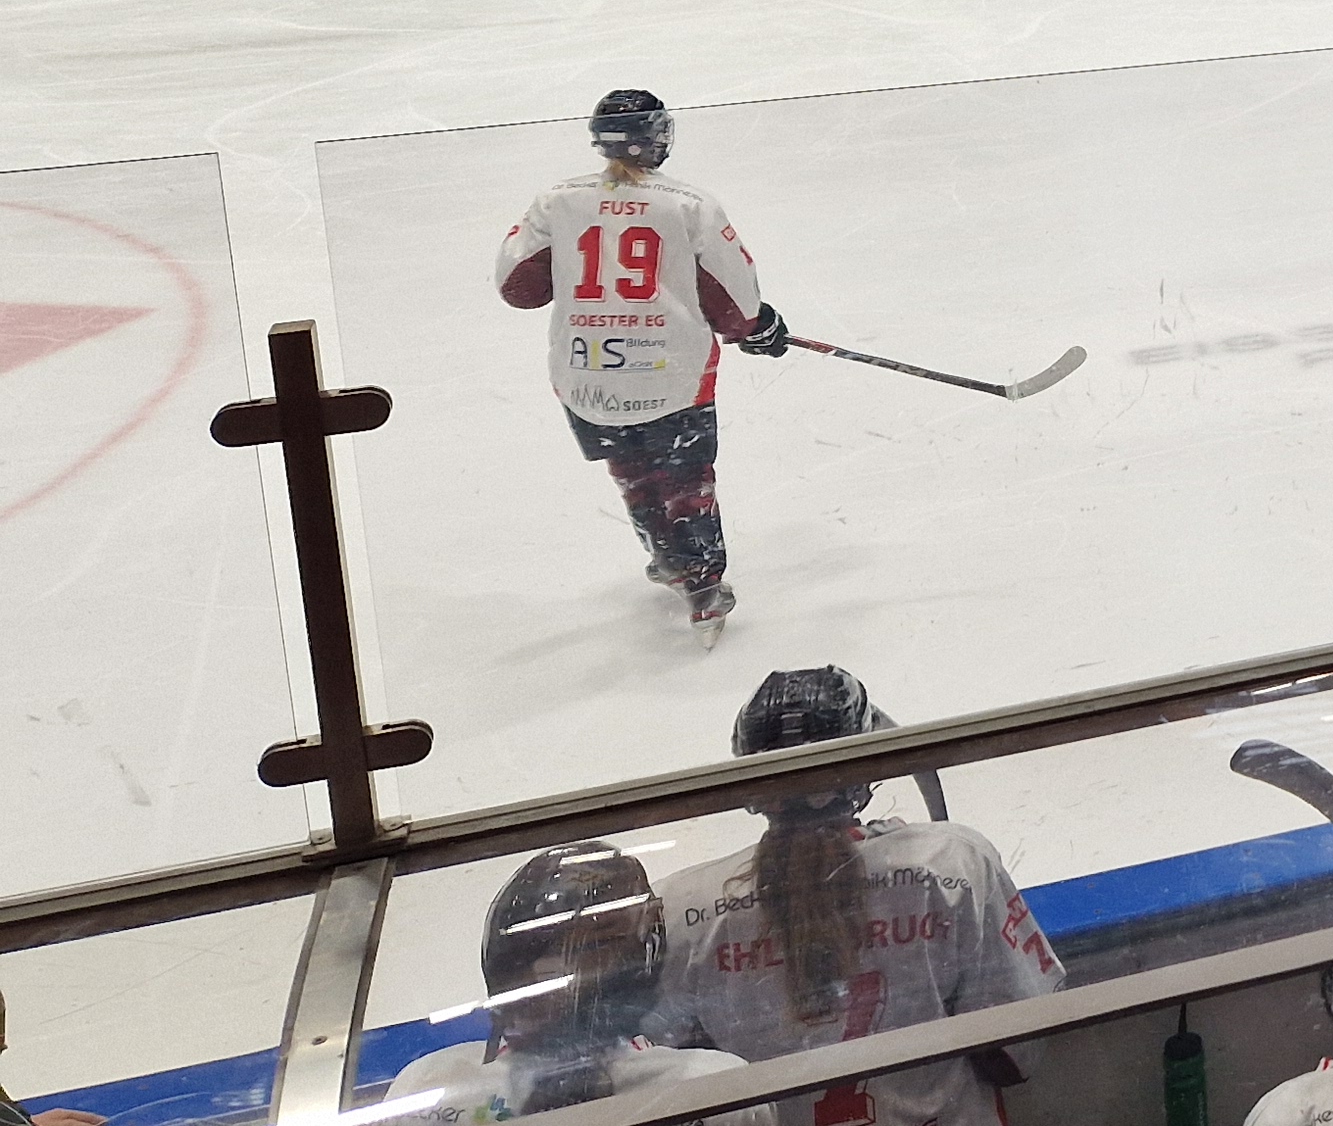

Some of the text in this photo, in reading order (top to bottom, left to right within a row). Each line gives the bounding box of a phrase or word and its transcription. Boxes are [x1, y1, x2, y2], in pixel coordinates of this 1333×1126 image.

[599, 200, 650, 216] FUST
[573, 225, 664, 303] 19
[569, 314, 666, 328] SOESTER EG
[623, 398, 668, 412] SOEST
[685, 906, 711, 927] Dr.
